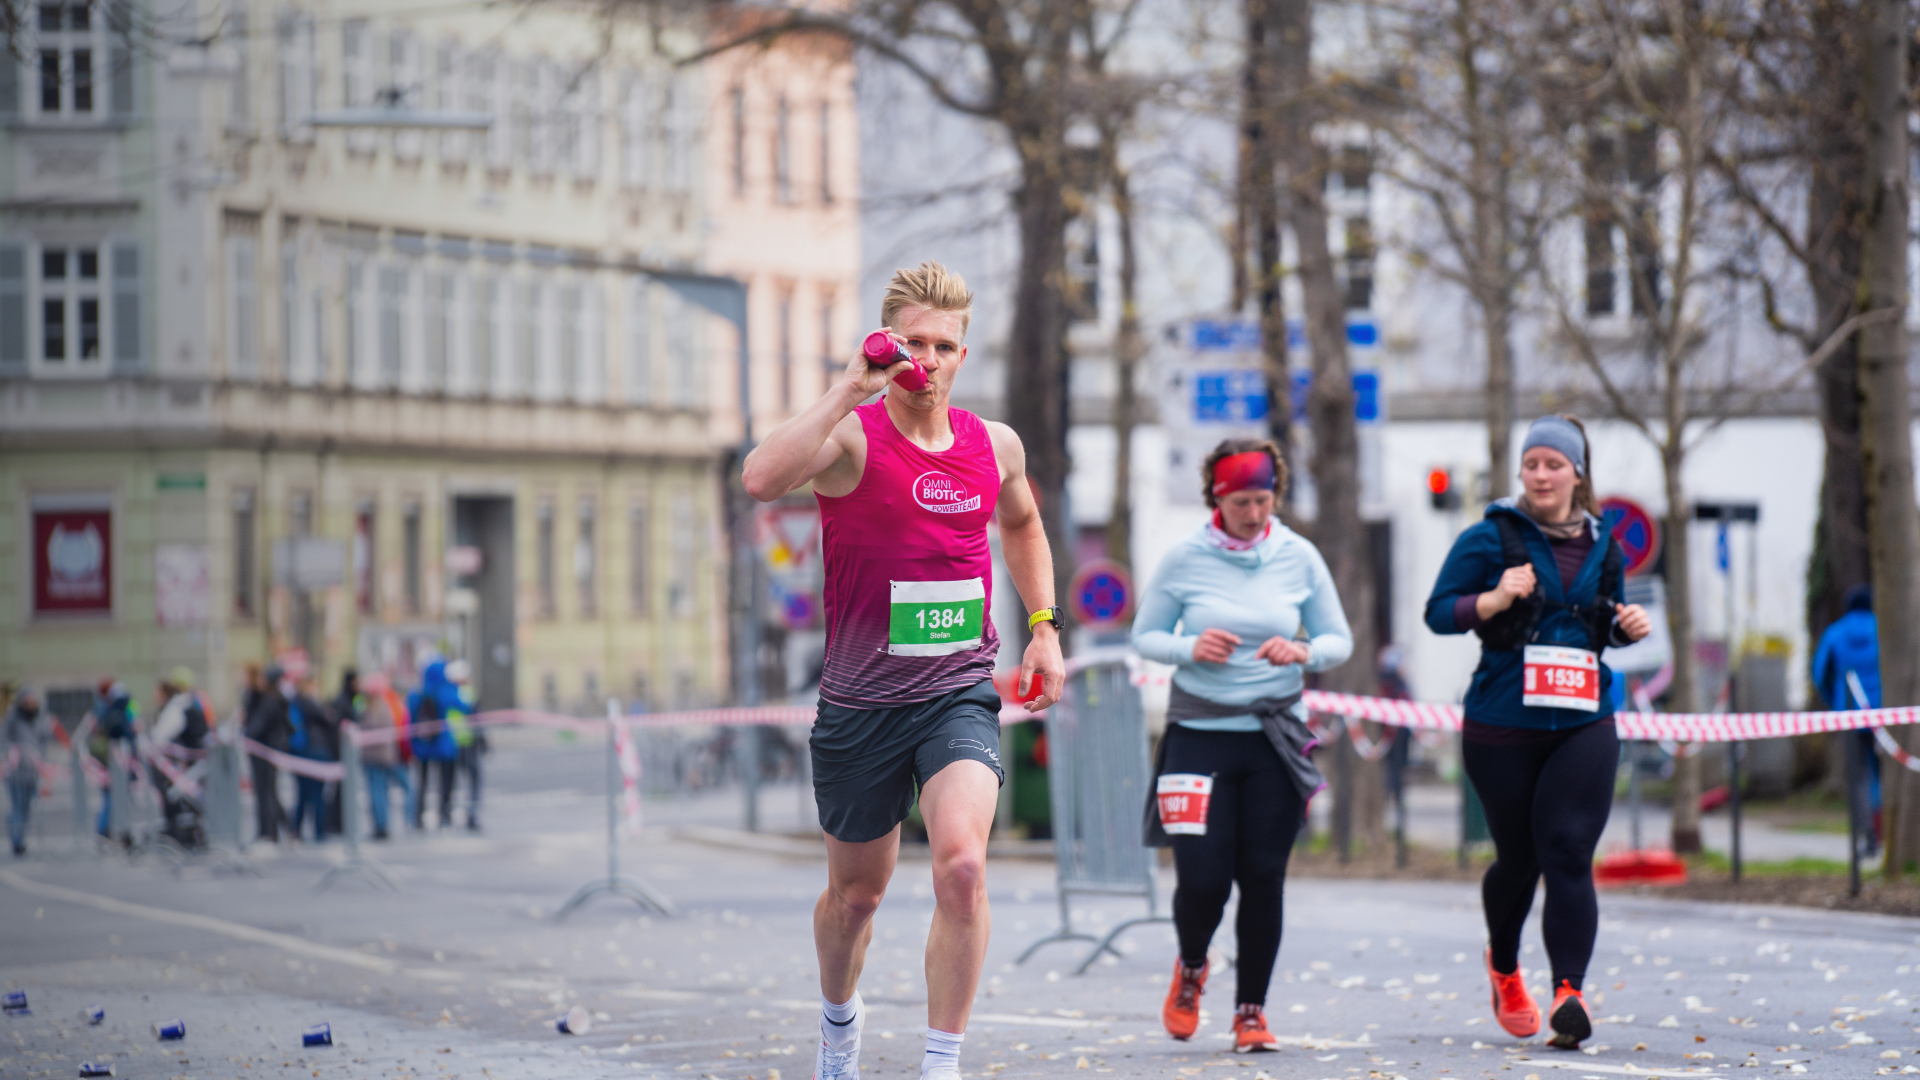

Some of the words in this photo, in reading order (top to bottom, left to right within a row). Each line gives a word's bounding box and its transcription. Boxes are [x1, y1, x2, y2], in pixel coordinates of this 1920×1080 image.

[932, 497, 979, 513] POWERTEAM
[915, 607, 966, 629] 1384
[929, 631, 951, 640] Stefan
[1544, 667, 1586, 689] 1535
